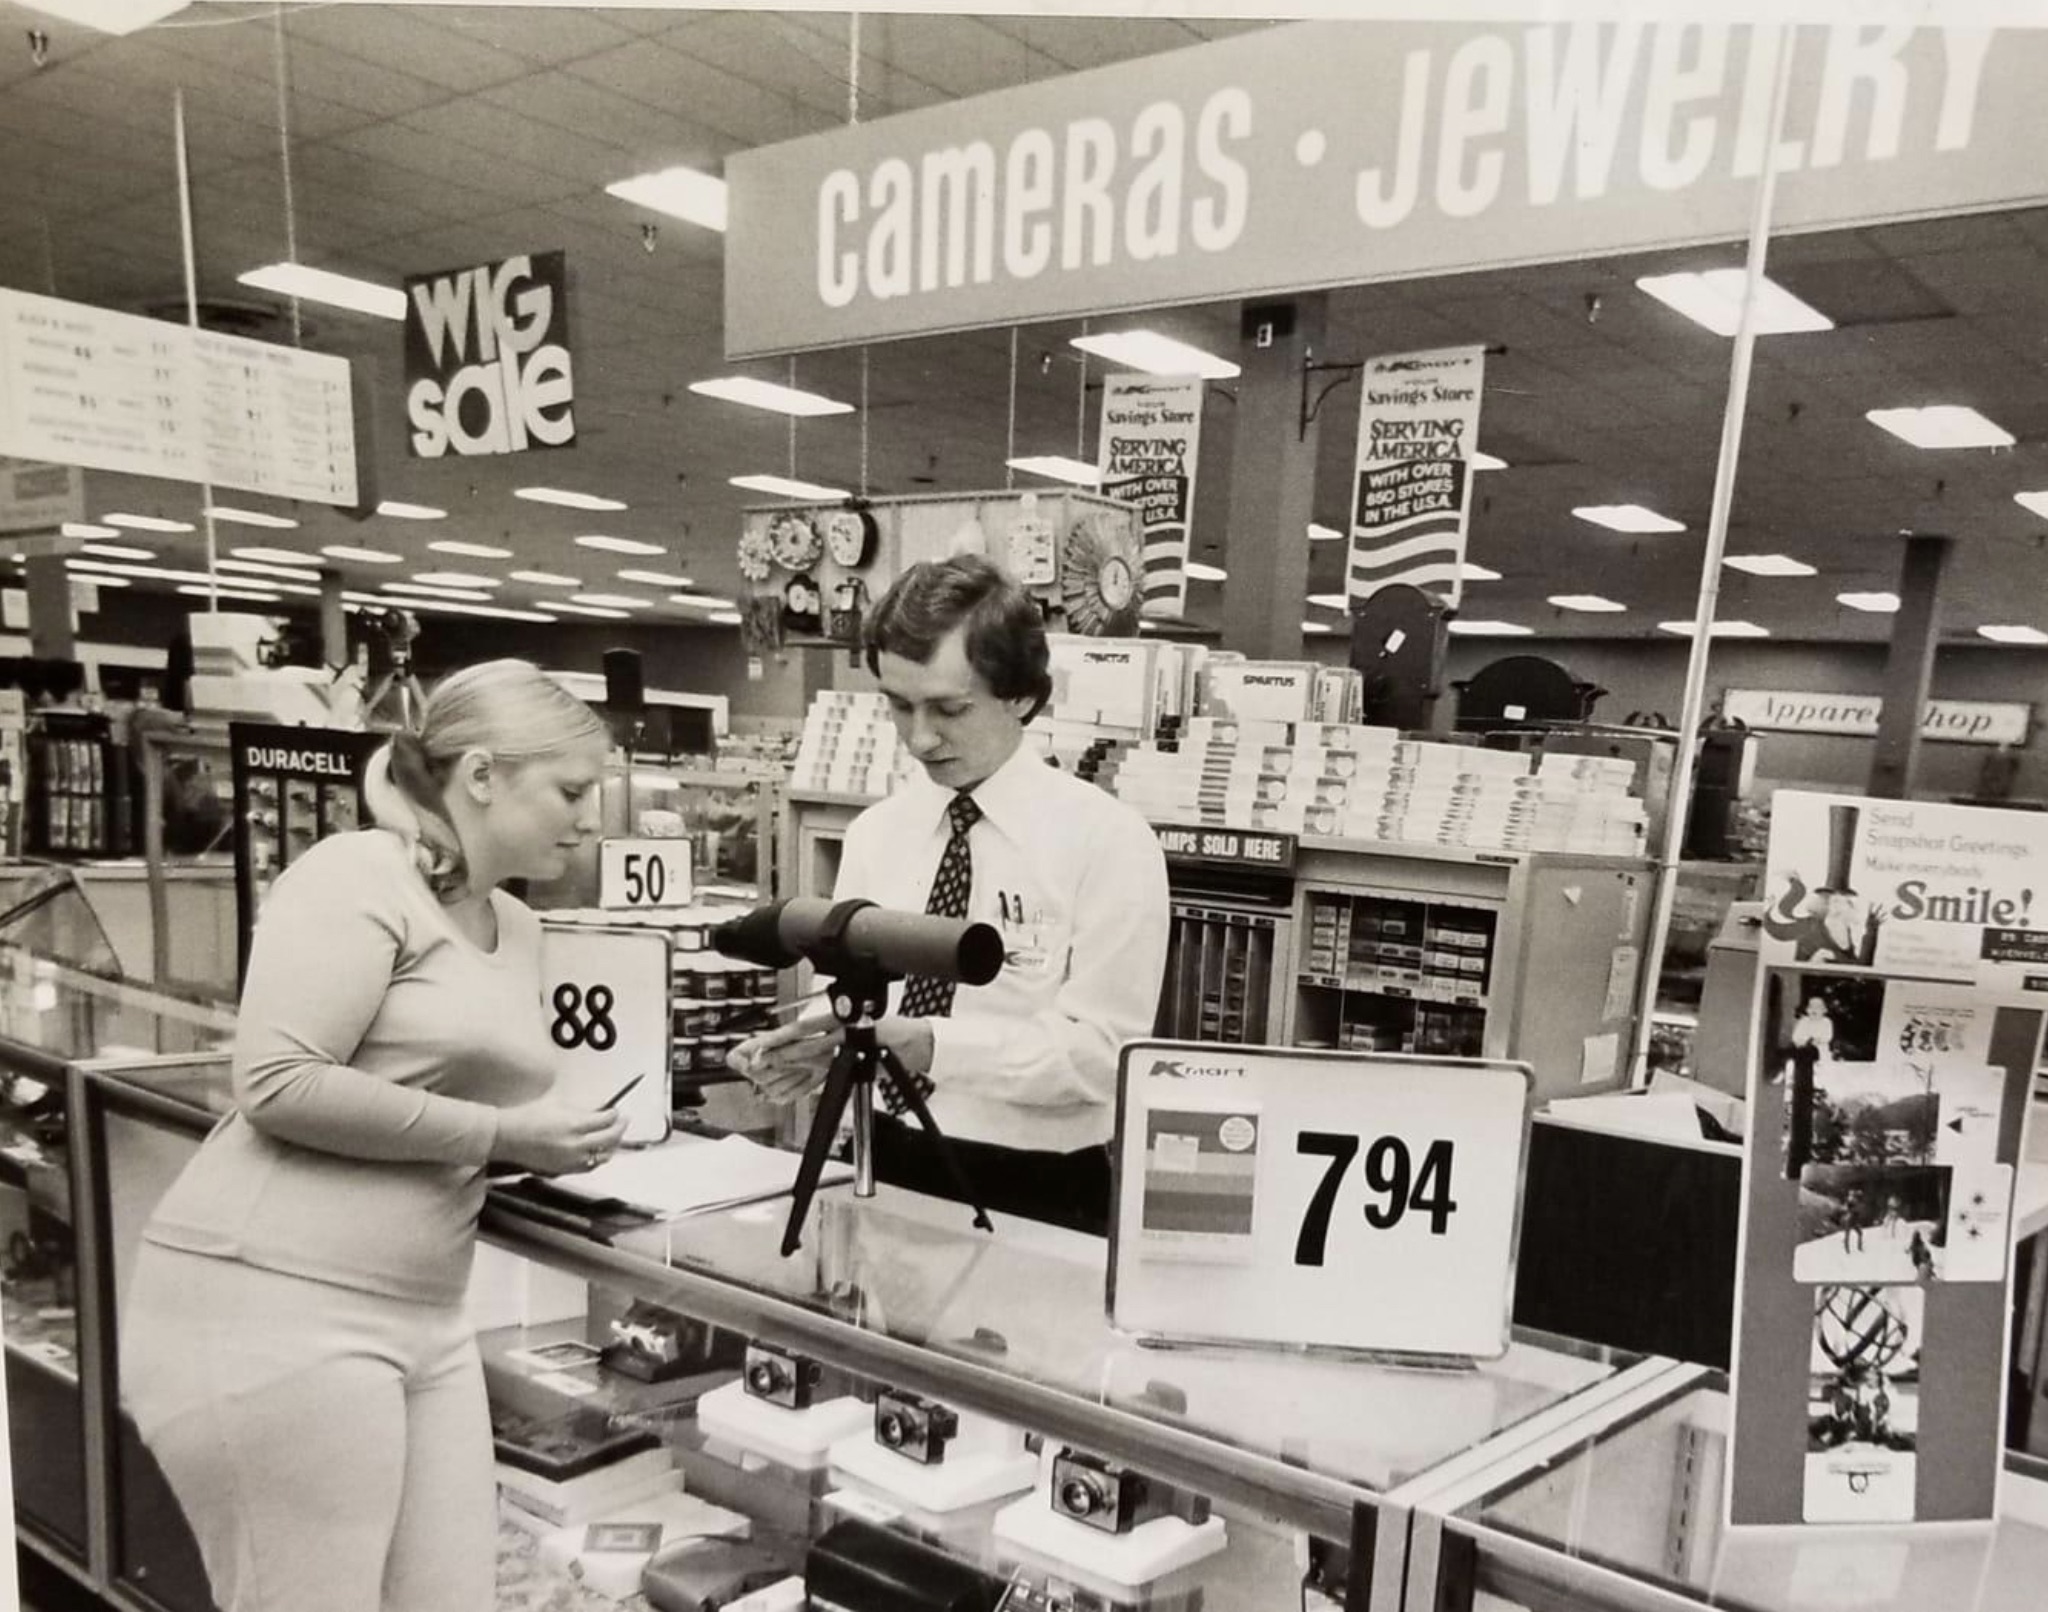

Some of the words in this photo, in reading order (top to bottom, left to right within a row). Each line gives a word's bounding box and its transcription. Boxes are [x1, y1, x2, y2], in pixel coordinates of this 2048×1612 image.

[412, 255, 553, 370] WIG
[408, 344, 576, 458] sale
[1367, 388, 1428, 406] Savings
[1432, 385, 1475, 402] Store
[1107, 410, 1157, 427] Savings
[1161, 408, 1195, 423] Store
[1370, 418, 1465, 441] SERVING
[1110, 436, 1187, 457] SERVING
[1366, 437, 1463, 462] AMERICA
[1107, 454, 1185, 475] AMERICA
[1369, 467, 1409, 489] WITH
[1412, 462, 1454, 479] OVER
[1109, 481, 1142, 501] WITH
[1145, 478, 1177, 492] OVER
[1398, 478, 1454, 500] STORES
[1365, 509, 1380, 524] IN
[1382, 501, 1411, 521] THE
[1763, 696, 1876, 724] Appare
[1923, 705, 1993, 735] hop
[247, 746, 352, 776] DURACELL
[1159, 830, 1197, 854] AMPS
[1202, 834, 1239, 857] SOLD
[1243, 837, 1282, 861] HERE
[625, 854, 666, 904] 50
[1892, 880, 2034, 928] Smile!
[551, 983, 617, 1052] 88
